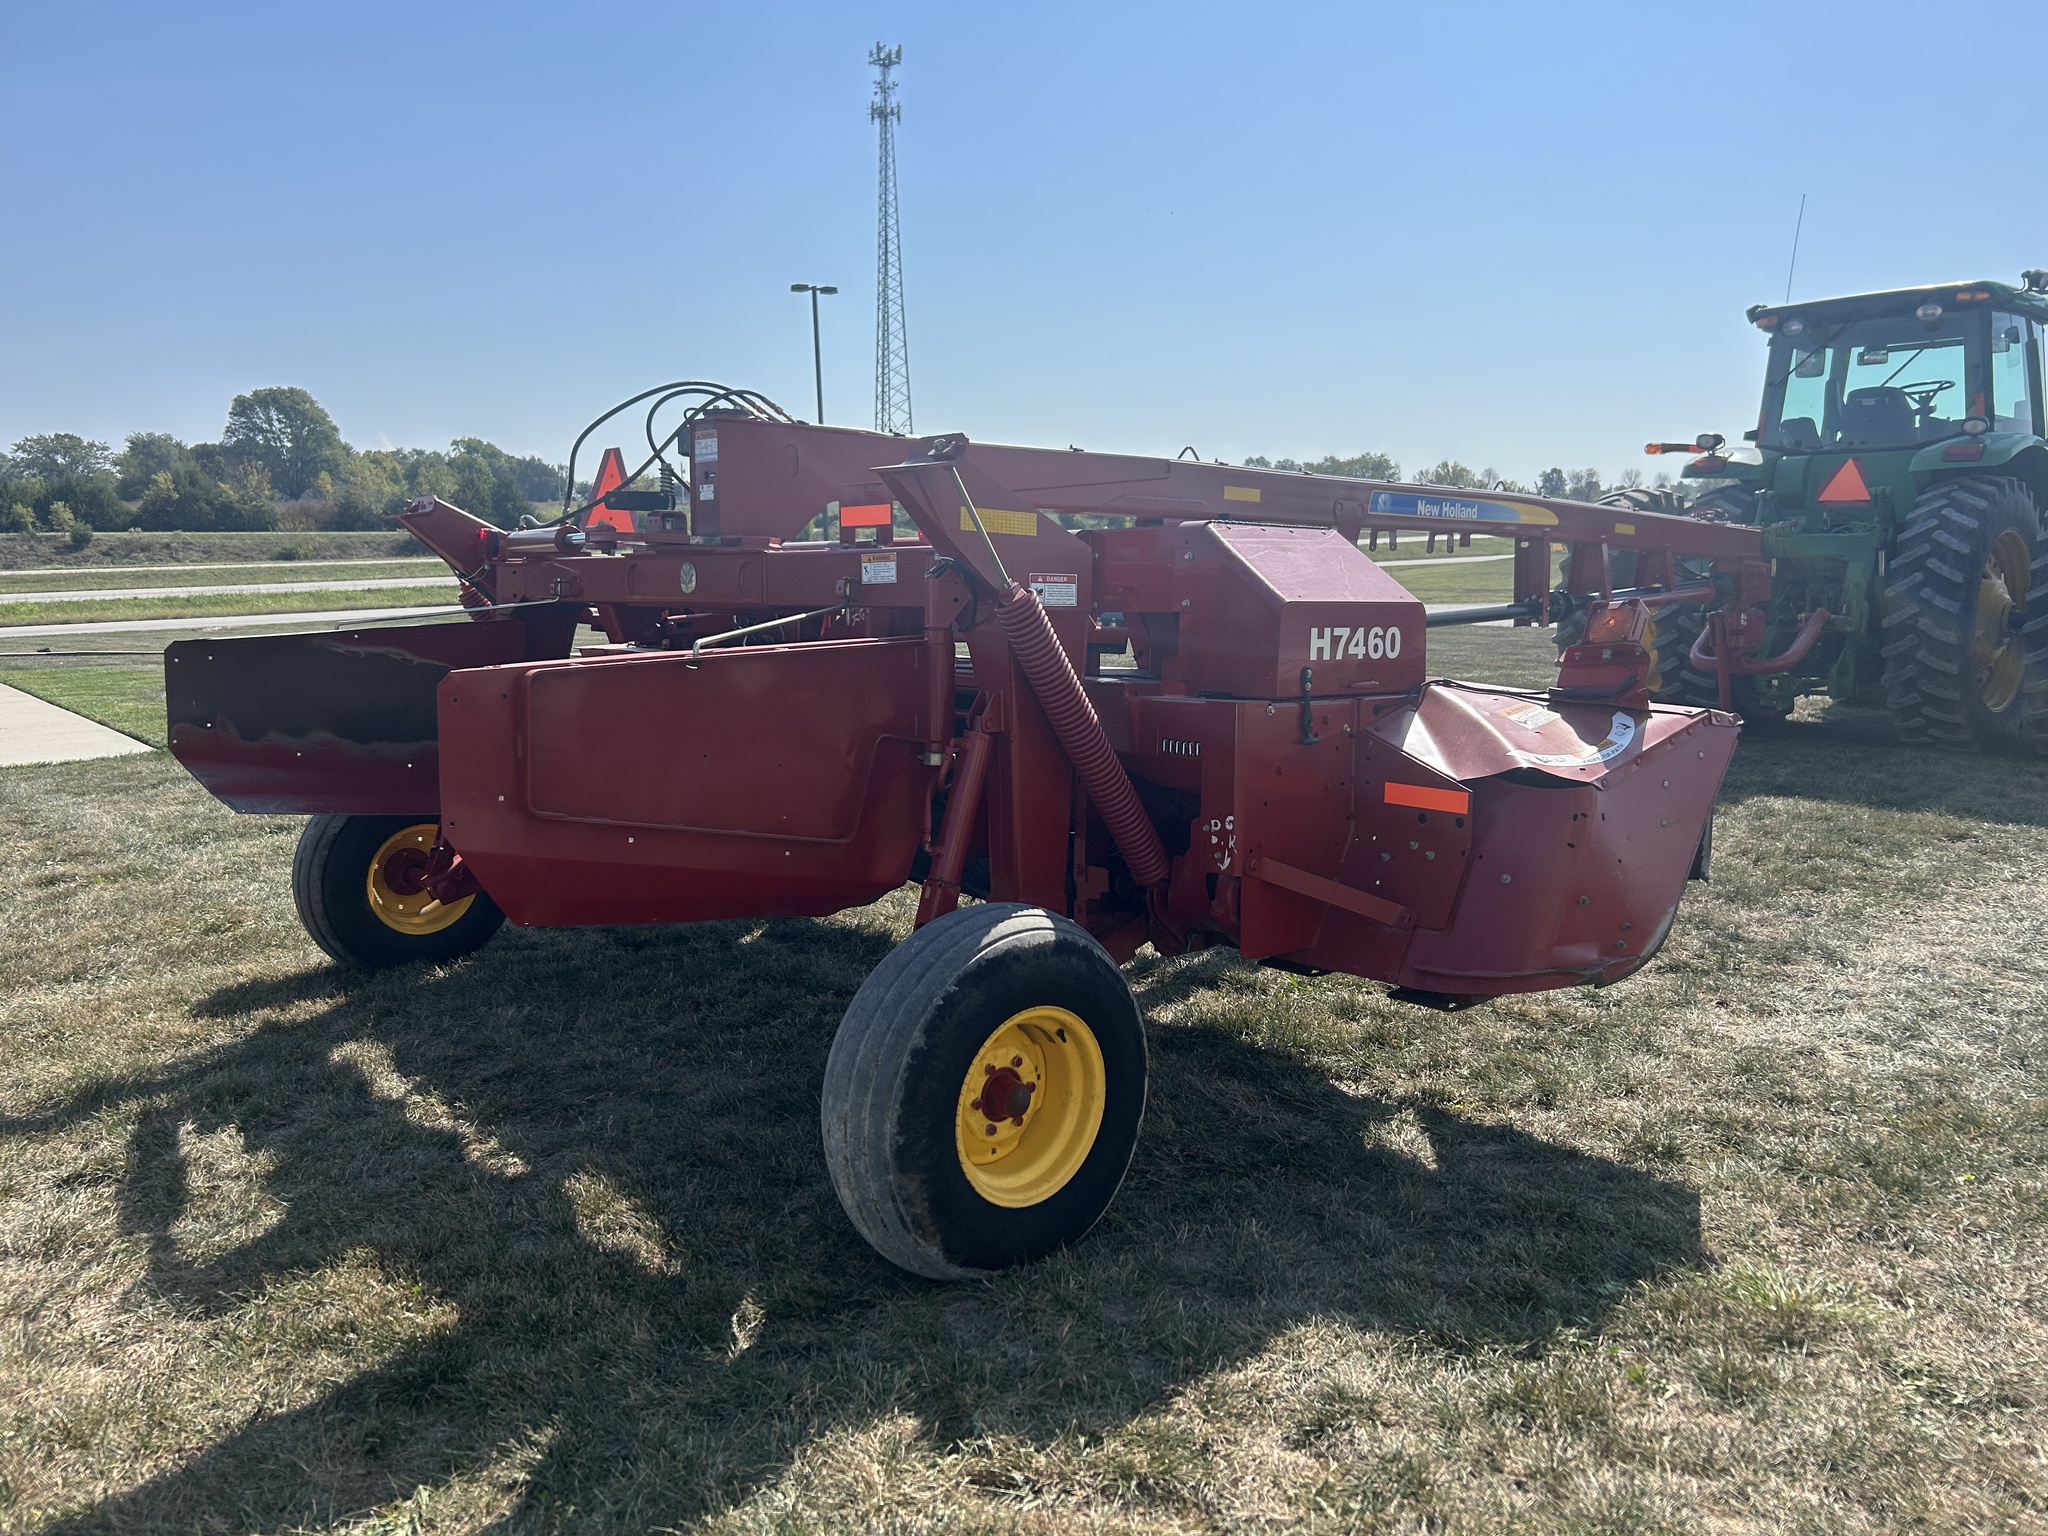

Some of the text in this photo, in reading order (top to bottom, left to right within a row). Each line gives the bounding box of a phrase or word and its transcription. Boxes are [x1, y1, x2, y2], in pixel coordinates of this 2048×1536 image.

[1417, 500, 1478, 519] New Holland
[1309, 627, 1401, 660] H7460
